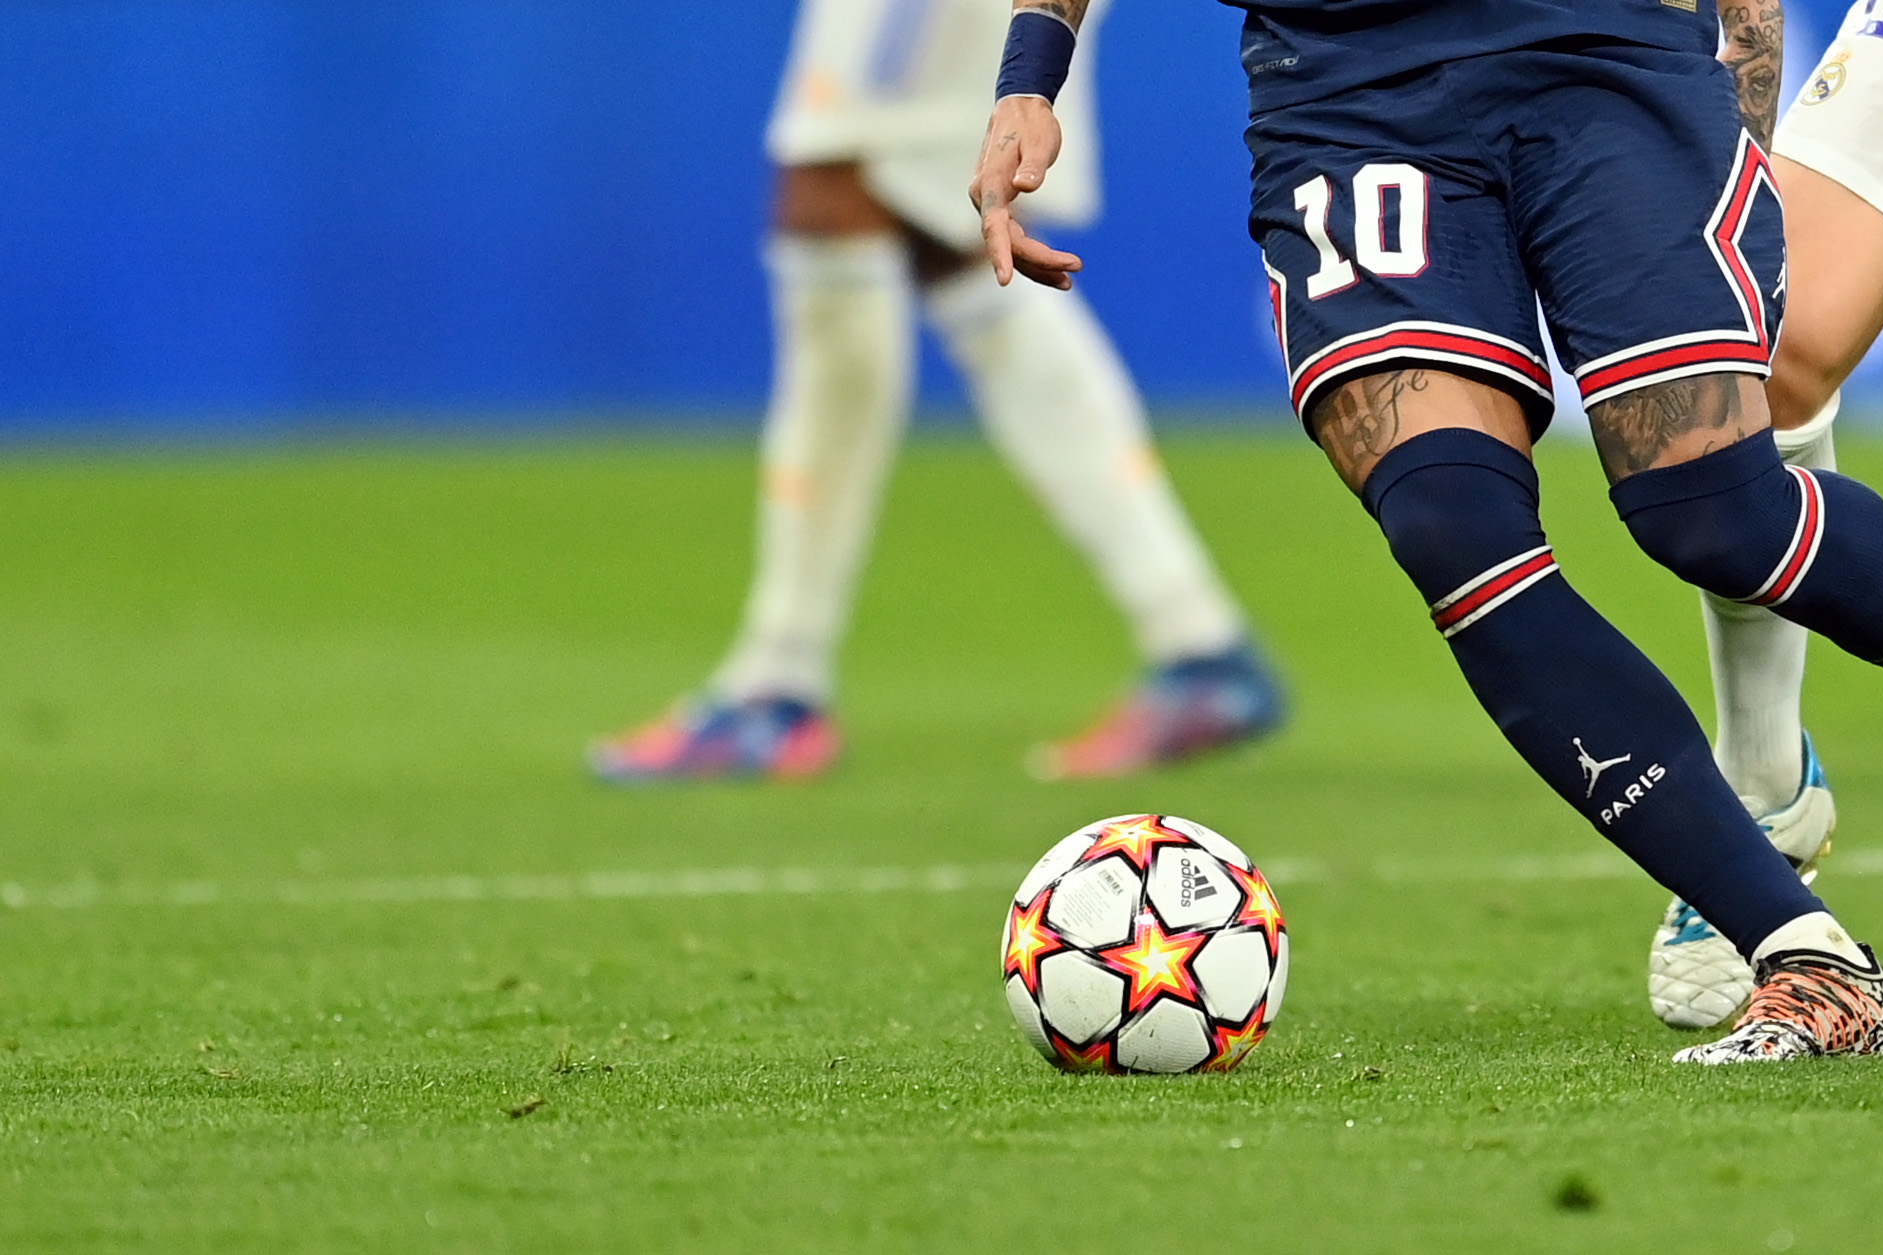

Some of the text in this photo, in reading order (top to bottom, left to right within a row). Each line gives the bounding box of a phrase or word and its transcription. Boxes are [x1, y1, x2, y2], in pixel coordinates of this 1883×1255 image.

[1293, 163, 1430, 302] 10
[1600, 763, 1666, 825] PARIS
[1180, 858, 1196, 908] adidas
